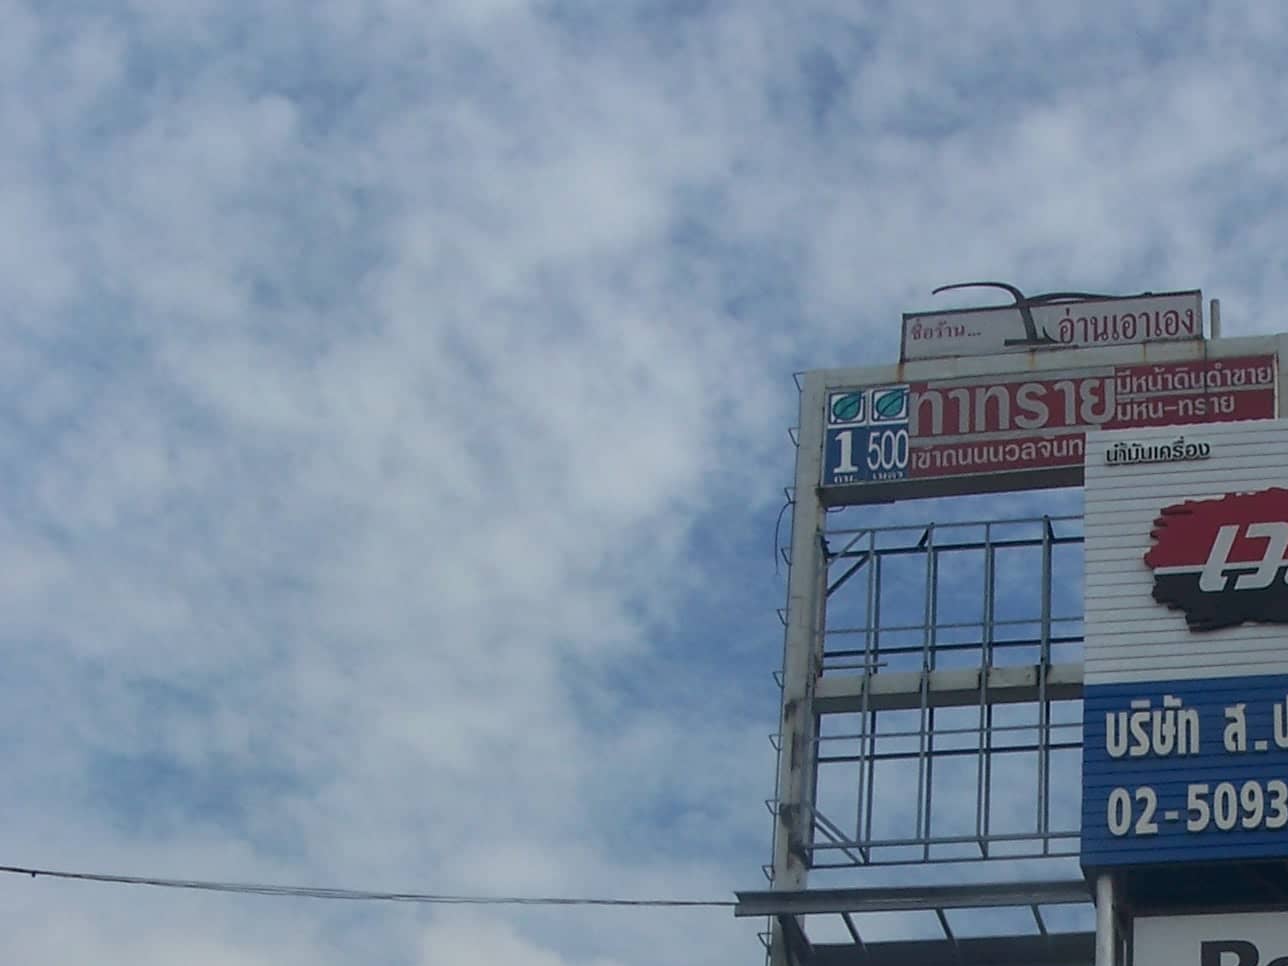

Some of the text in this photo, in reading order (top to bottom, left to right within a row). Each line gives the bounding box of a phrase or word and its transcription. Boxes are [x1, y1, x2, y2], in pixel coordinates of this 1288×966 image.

[1059, 307, 1195, 344] อ่านเอาเอง
[1116, 362, 1273, 395] มีหน้าดินดำขาย
[833, 430, 859, 474] 1
[866, 429, 909, 470] 500
[1105, 436, 1211, 463] น้ำมันเครื่อง
[1105, 694, 1200, 758] บริษัท
